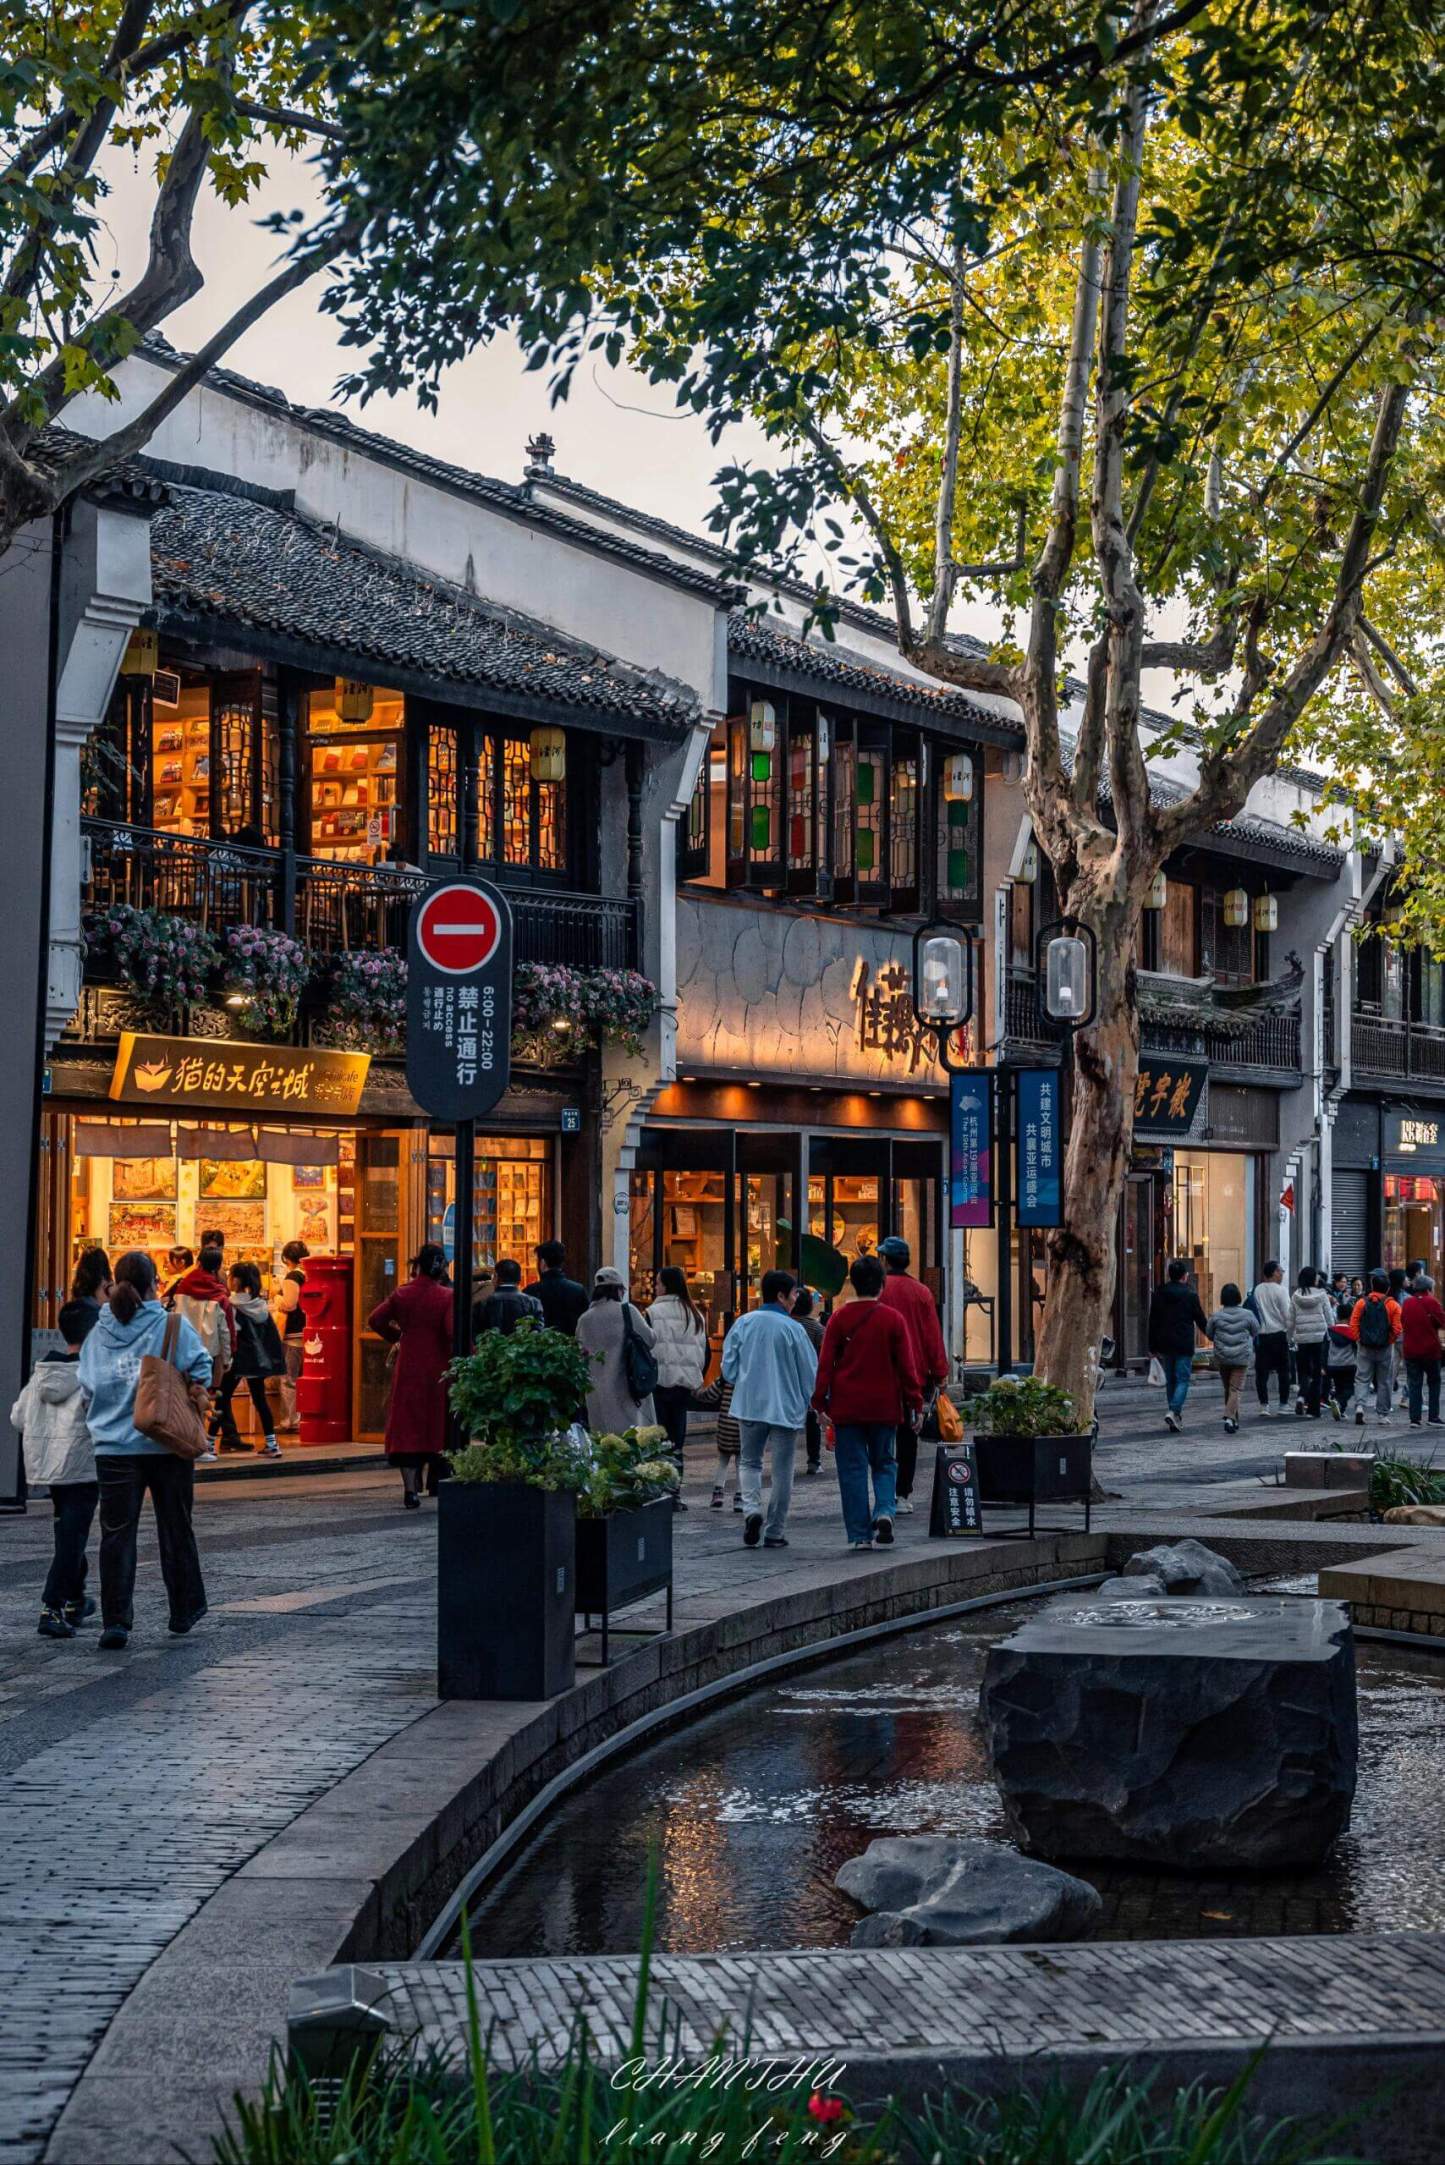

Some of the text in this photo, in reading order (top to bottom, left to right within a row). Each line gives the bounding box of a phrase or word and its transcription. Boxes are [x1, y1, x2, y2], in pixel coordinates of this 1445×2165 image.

[433, 986, 445, 1032] 通行止め
[444, 986, 455, 1048] no access
[456, 985, 479, 1085] 禁止通行
[171, 1055, 316, 1101] 猫的天空之城
[567, 1117, 576, 1129] 25
[1040, 1082, 1052, 1168] 共建文明城市
[1026, 1122, 1038, 1208] 共襄亚运盛会
[948, 1487, 961, 1527] 注意安全
